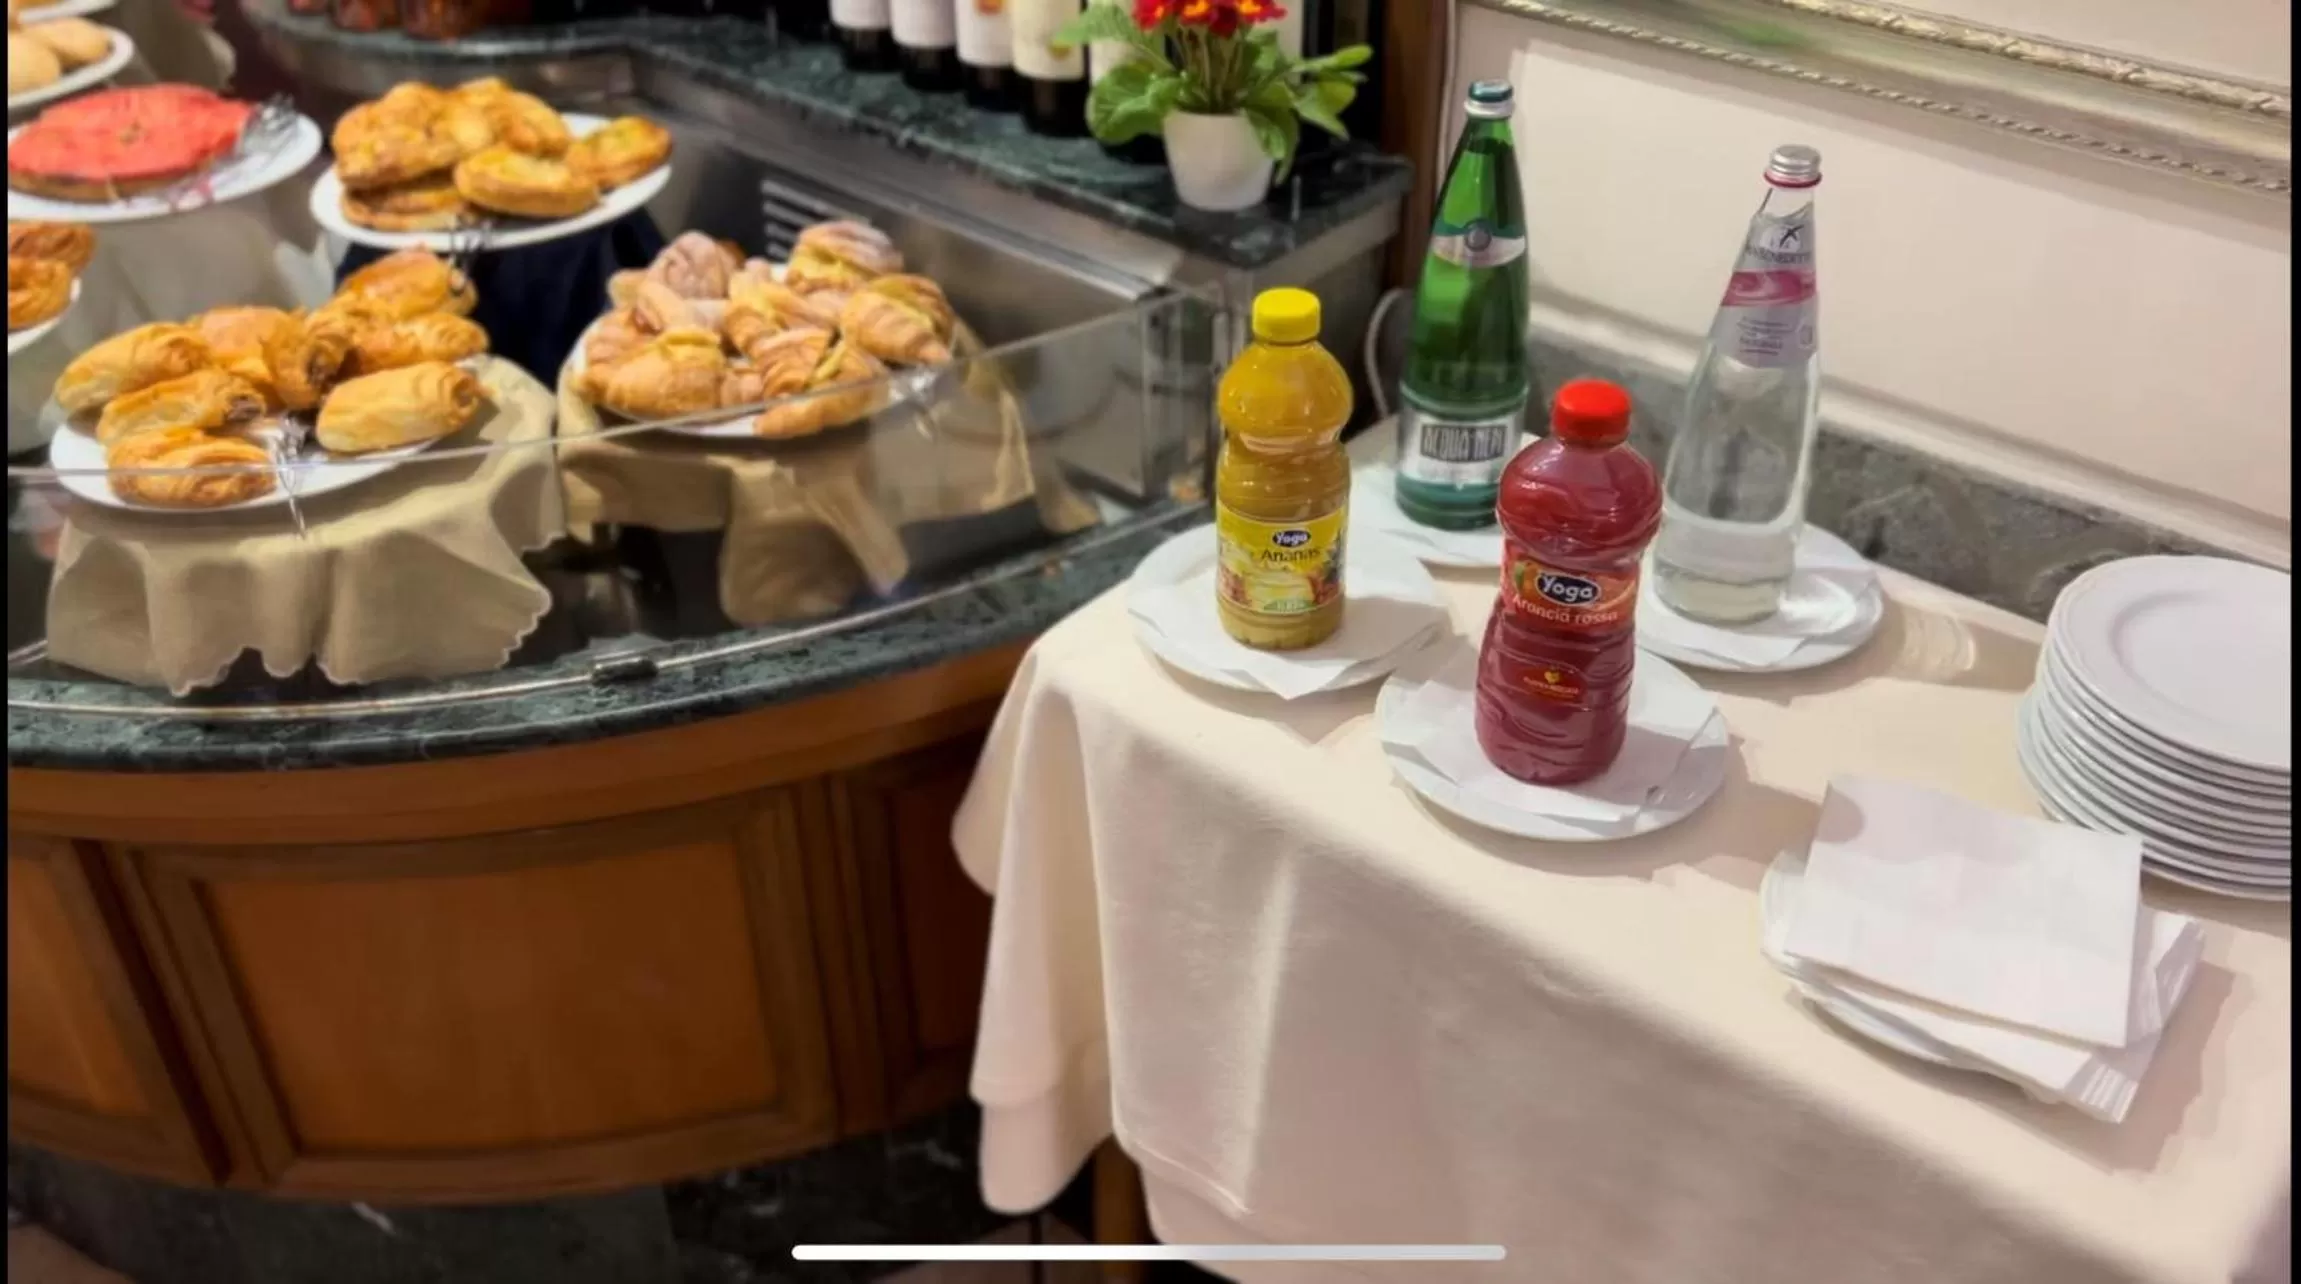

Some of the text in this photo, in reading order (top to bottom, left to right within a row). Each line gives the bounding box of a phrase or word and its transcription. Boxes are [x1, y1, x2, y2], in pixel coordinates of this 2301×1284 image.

[1423, 426, 1470, 460] ACQUA
[1276, 531, 1308, 545] Yoga
[1261, 548, 1321, 561] Ananas
[1541, 575, 1594, 603] Yoga
[1511, 593, 1619, 625] Arancia rossa
